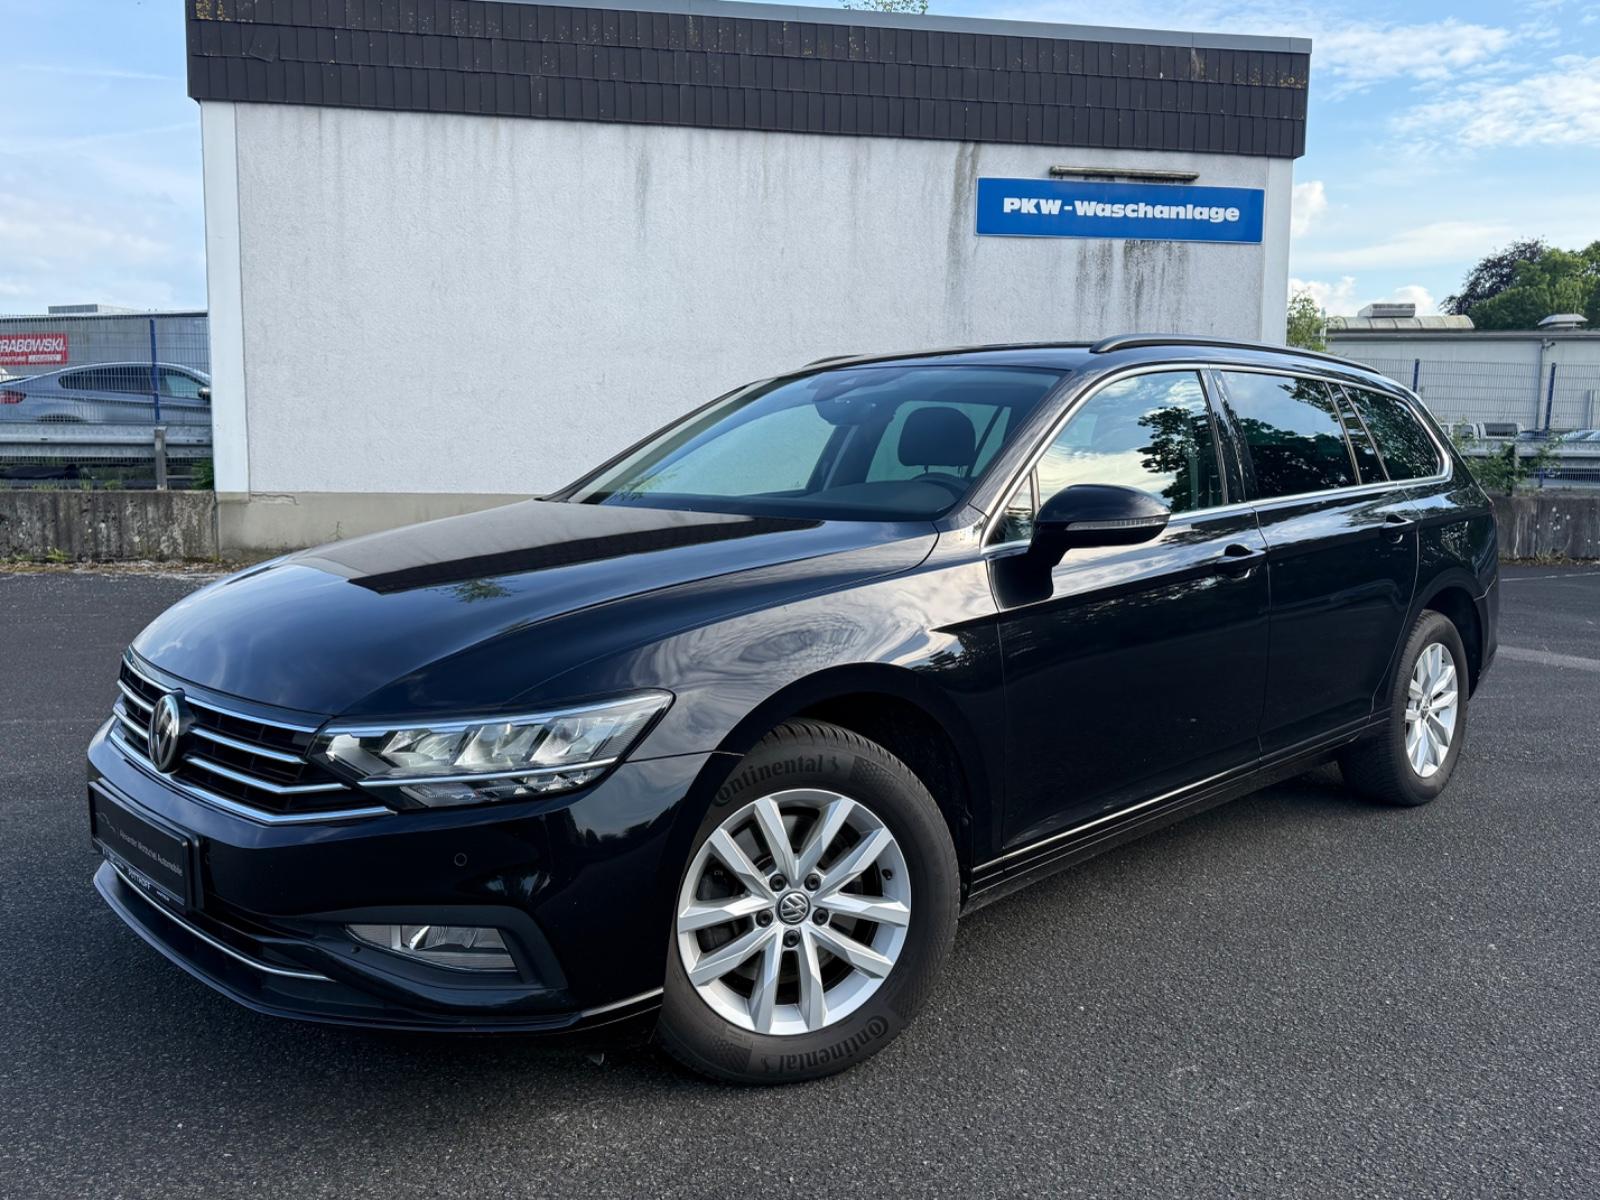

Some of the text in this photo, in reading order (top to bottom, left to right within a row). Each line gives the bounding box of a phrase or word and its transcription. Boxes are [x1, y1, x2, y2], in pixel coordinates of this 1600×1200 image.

[711, 753, 823, 807] Continental
[780, 892, 810, 923] VW
[778, 1015, 889, 1075] Continental
